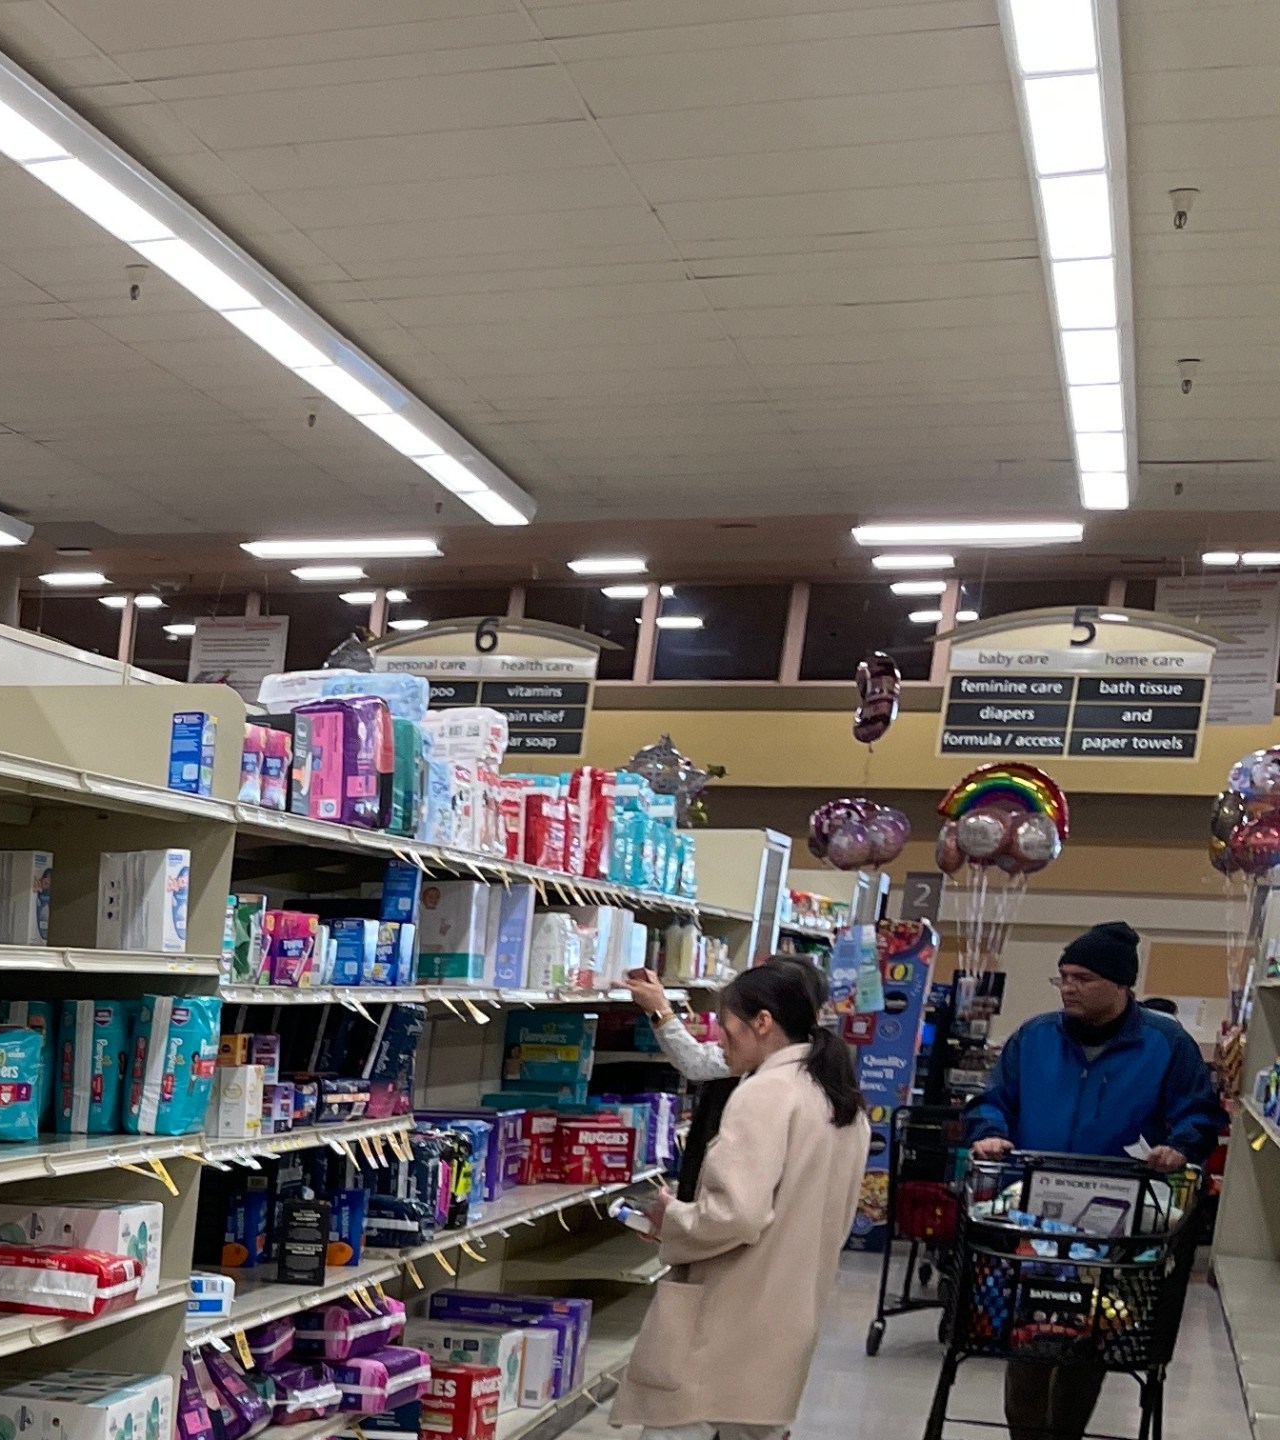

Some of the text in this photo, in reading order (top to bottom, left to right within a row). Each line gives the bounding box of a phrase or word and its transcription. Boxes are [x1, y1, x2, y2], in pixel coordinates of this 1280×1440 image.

[1070, 606, 1099, 647] 5
[475, 618, 500, 652] 6
[387, 660, 467, 672] personal care
[501, 659, 574, 672] health care
[978, 652, 1049, 667] baby care
[1105, 653, 1185, 667] home care
[507, 686, 562, 698] vitamins
[960, 679, 1063, 694] feminine care
[1099, 680, 1183, 695] bath tissue
[507, 710, 565, 723] ain relief
[980, 706, 1035, 722] diapers
[1121, 709, 1153, 722] and
[526, 737, 557, 750] soap
[943, 731, 1002, 746] formula
[1015, 735, 1064, 747] access.
[1082, 736, 1183, 751] paper towels
[913, 883, 932, 908] 2
[578, 1130, 629, 1145] HUGGIES
